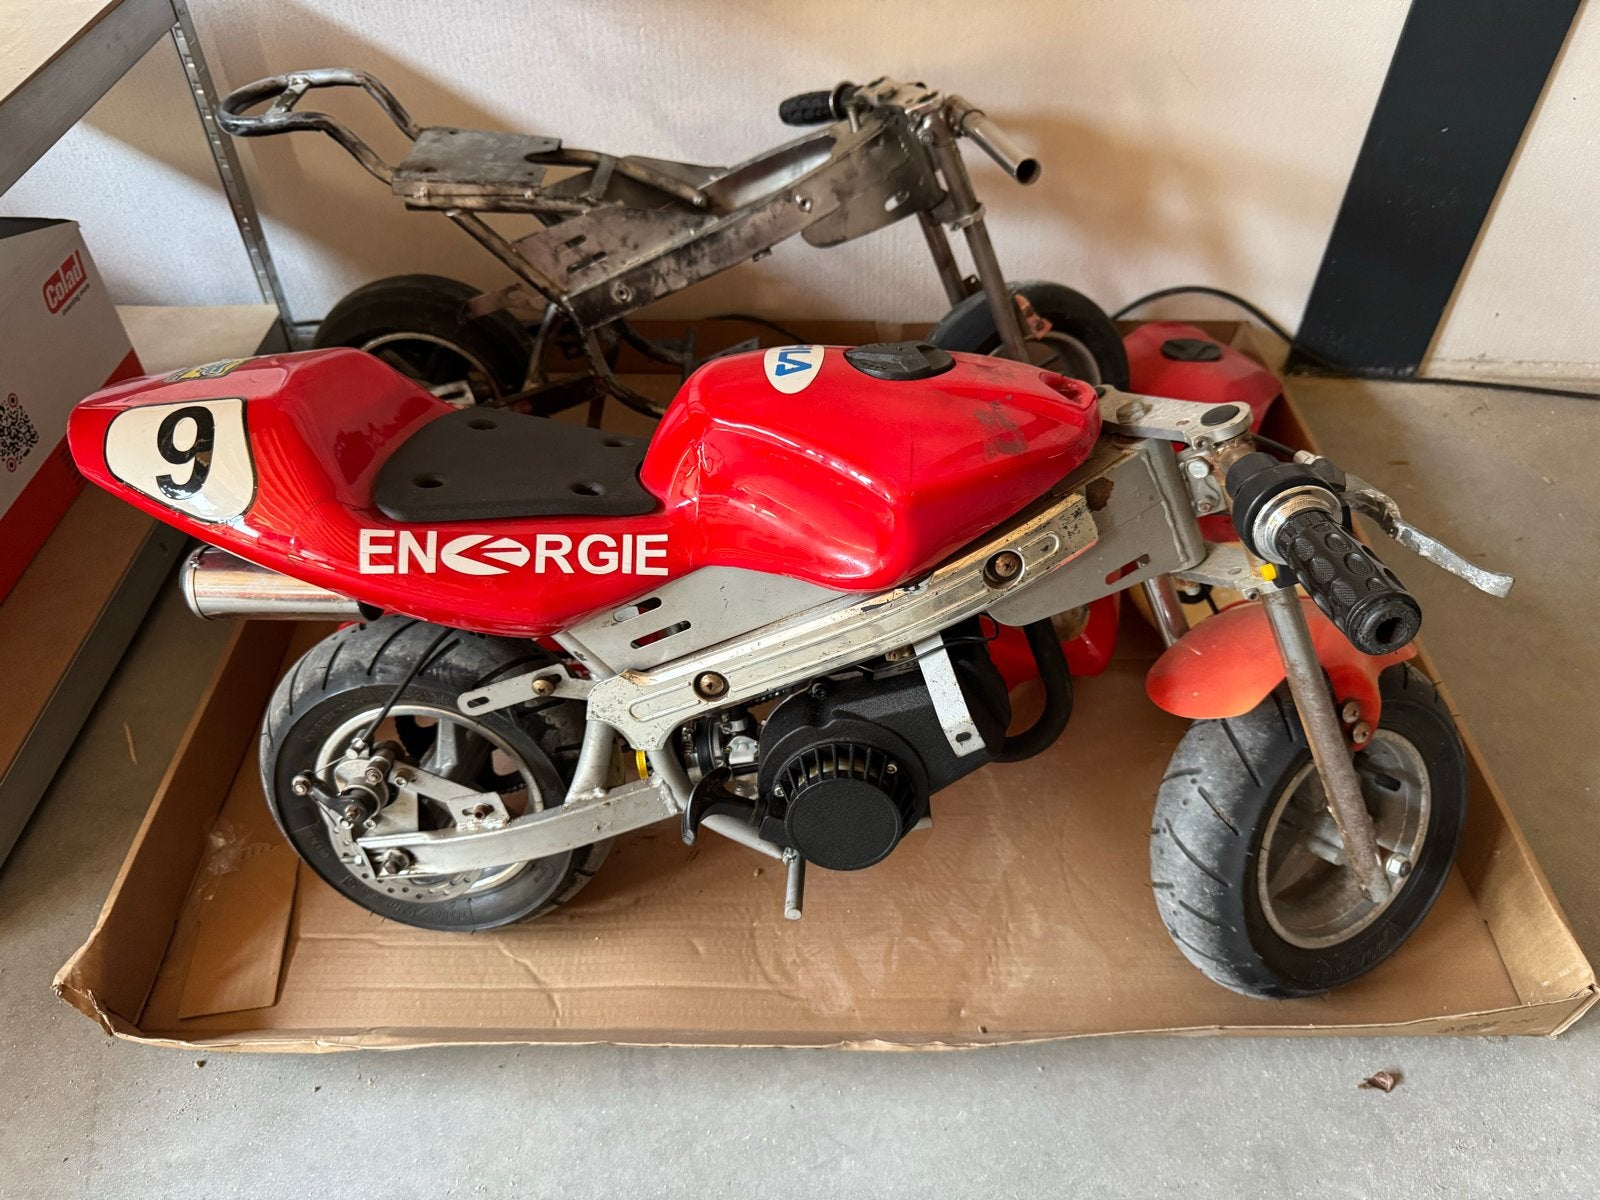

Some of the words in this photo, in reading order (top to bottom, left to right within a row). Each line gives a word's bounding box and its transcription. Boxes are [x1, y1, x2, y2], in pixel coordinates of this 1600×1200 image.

[46, 250, 82, 309] Colad
[775, 345, 813, 377] ILA
[156, 405, 215, 500] 9
